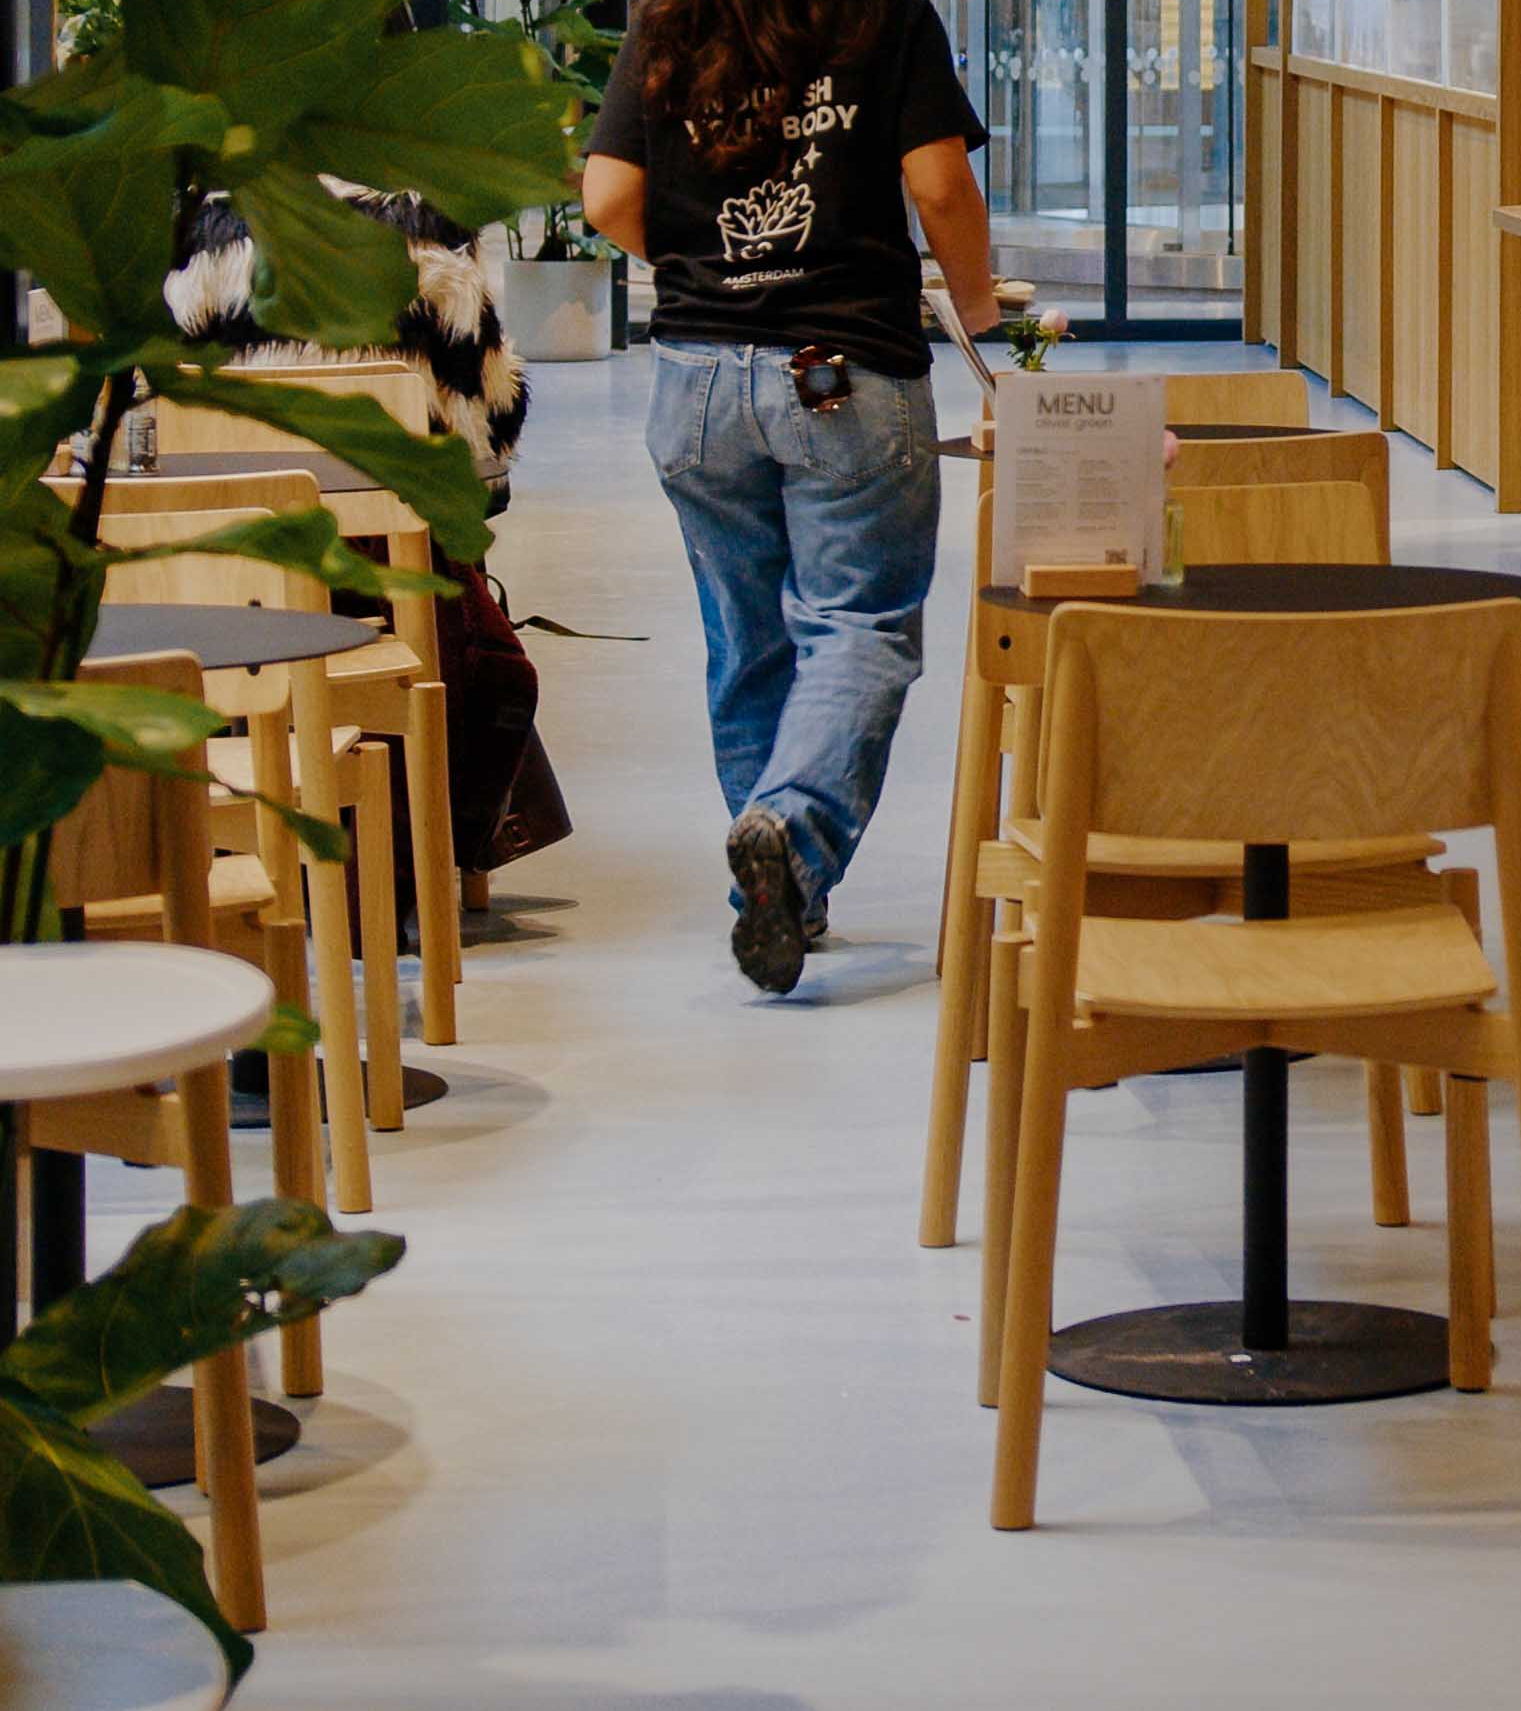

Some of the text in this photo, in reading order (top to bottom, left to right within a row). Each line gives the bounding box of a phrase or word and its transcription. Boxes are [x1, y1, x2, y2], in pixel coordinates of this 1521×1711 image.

[782, 104, 858, 140] BODY
[721, 267, 805, 284] AMSTERDAM
[1037, 392, 1115, 415] MENU
